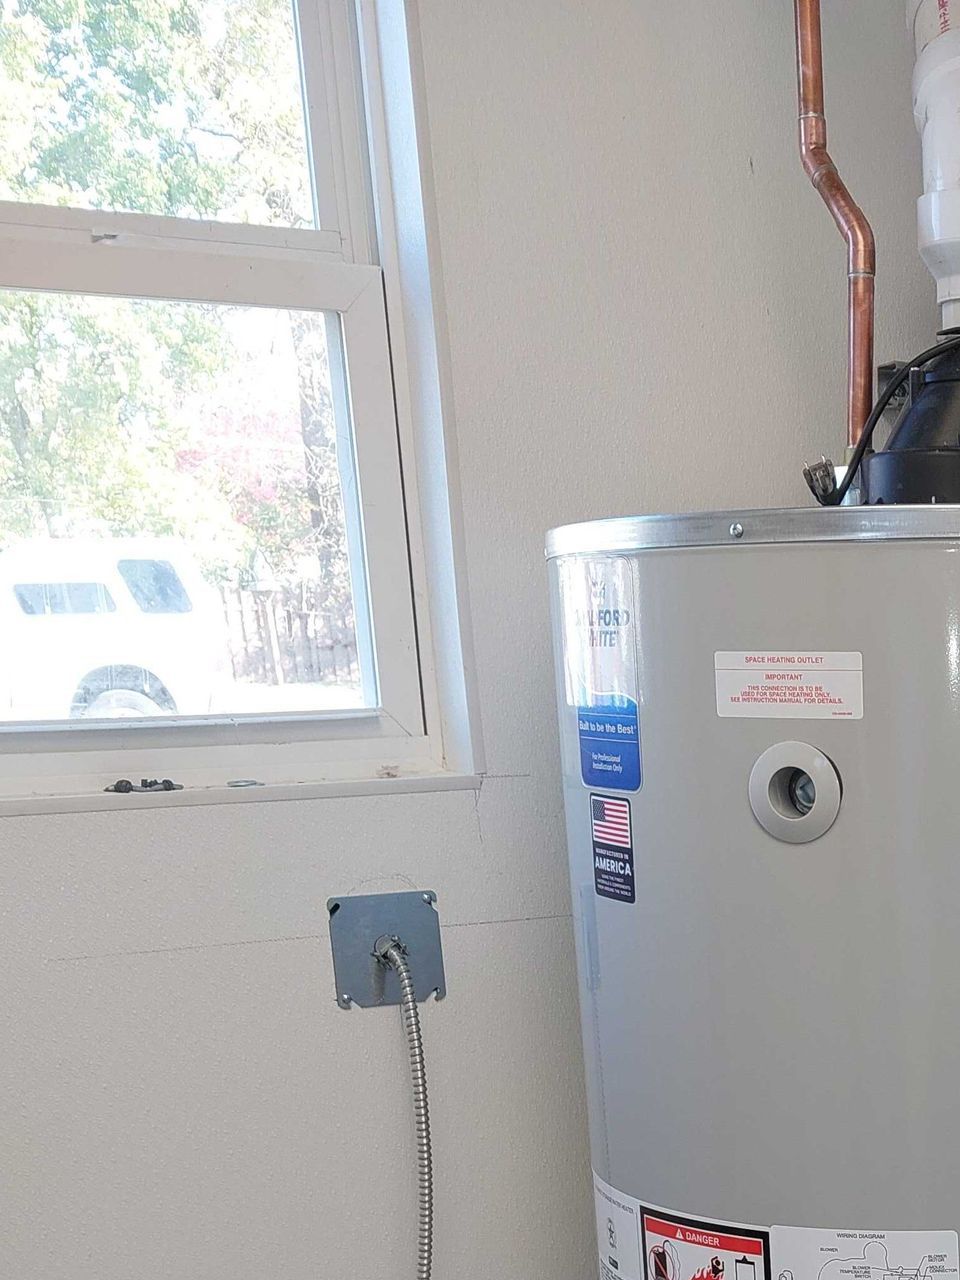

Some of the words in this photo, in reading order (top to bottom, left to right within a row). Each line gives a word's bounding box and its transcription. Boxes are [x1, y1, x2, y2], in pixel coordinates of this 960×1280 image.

[596, 721, 604, 731] be
[606, 722, 615, 732] the
[618, 723, 634, 734] Best
[596, 856, 631, 876] AMERICA
[686, 1232, 720, 1246] DANGER
